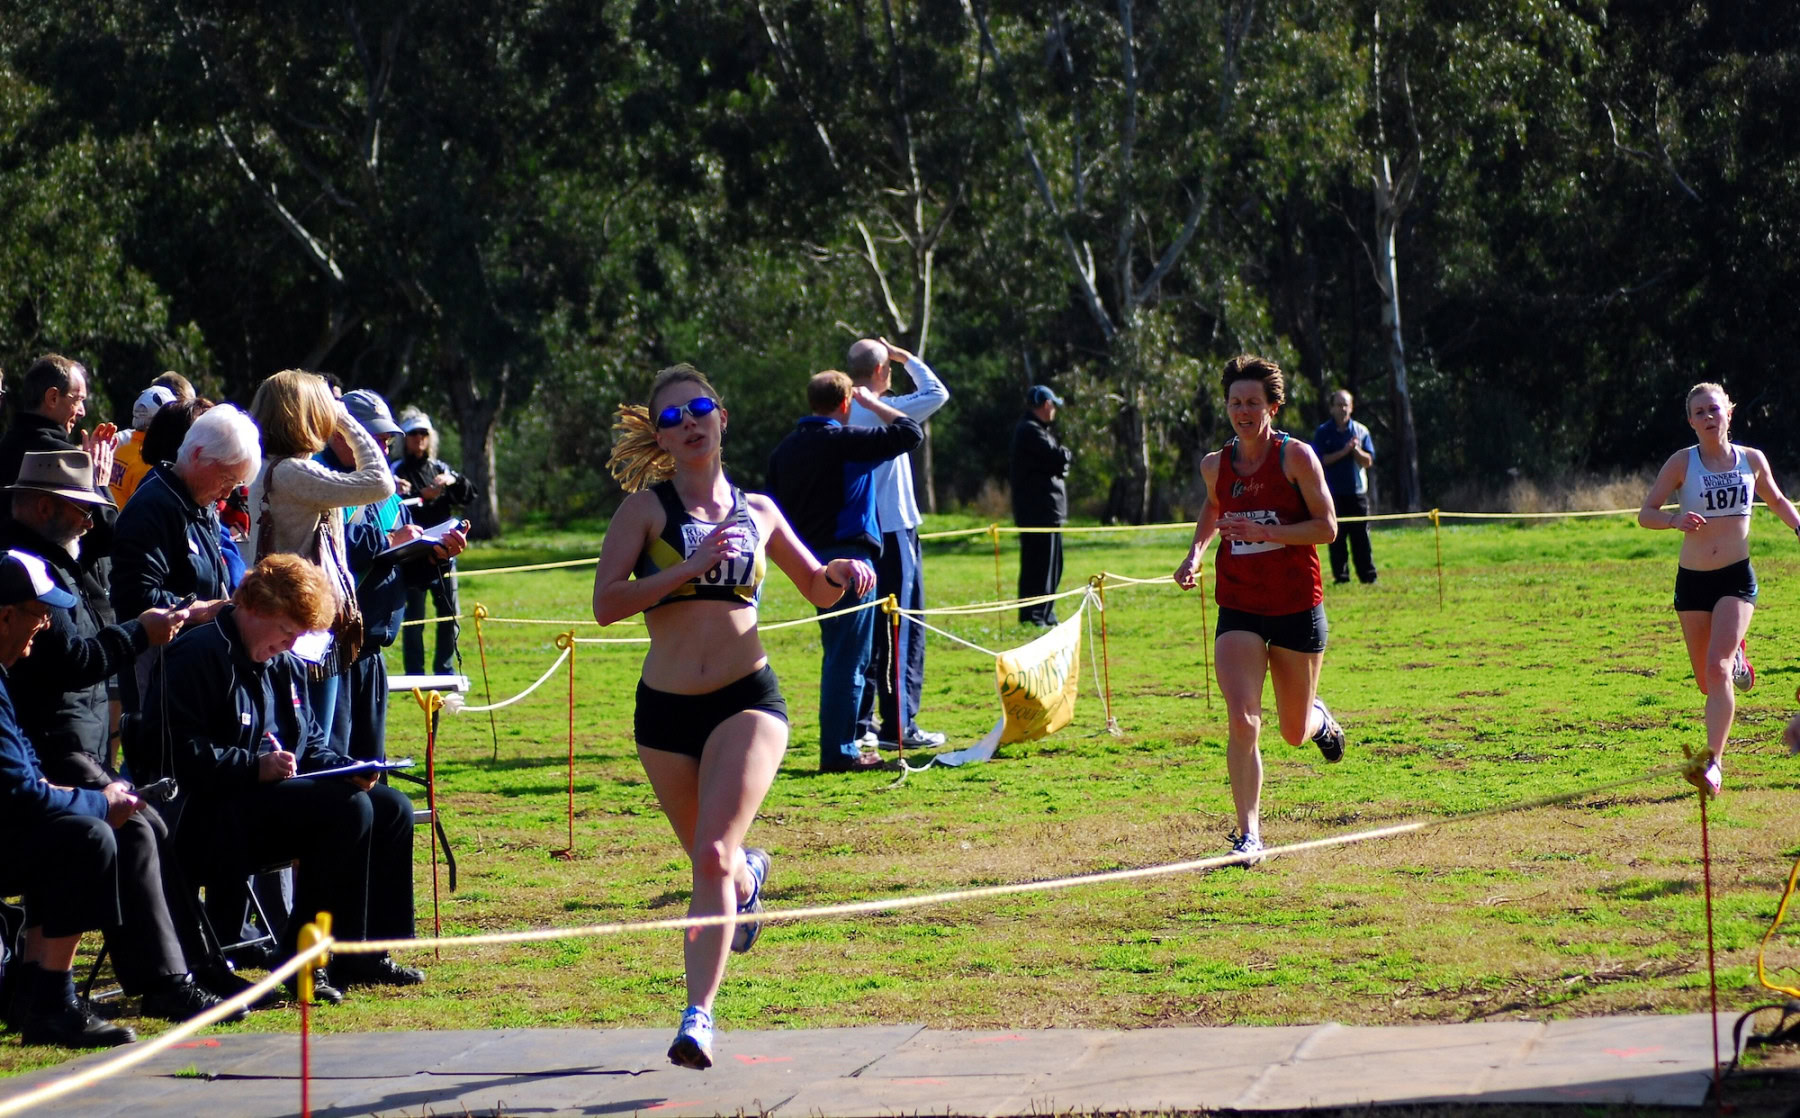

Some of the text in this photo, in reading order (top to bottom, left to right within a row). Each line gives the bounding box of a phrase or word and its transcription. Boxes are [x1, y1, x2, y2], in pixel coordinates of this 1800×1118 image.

[1702, 472, 1738, 481] RUNNERS
[1704, 479, 1732, 488] WORLD
[1704, 484, 1748, 511] 1874
